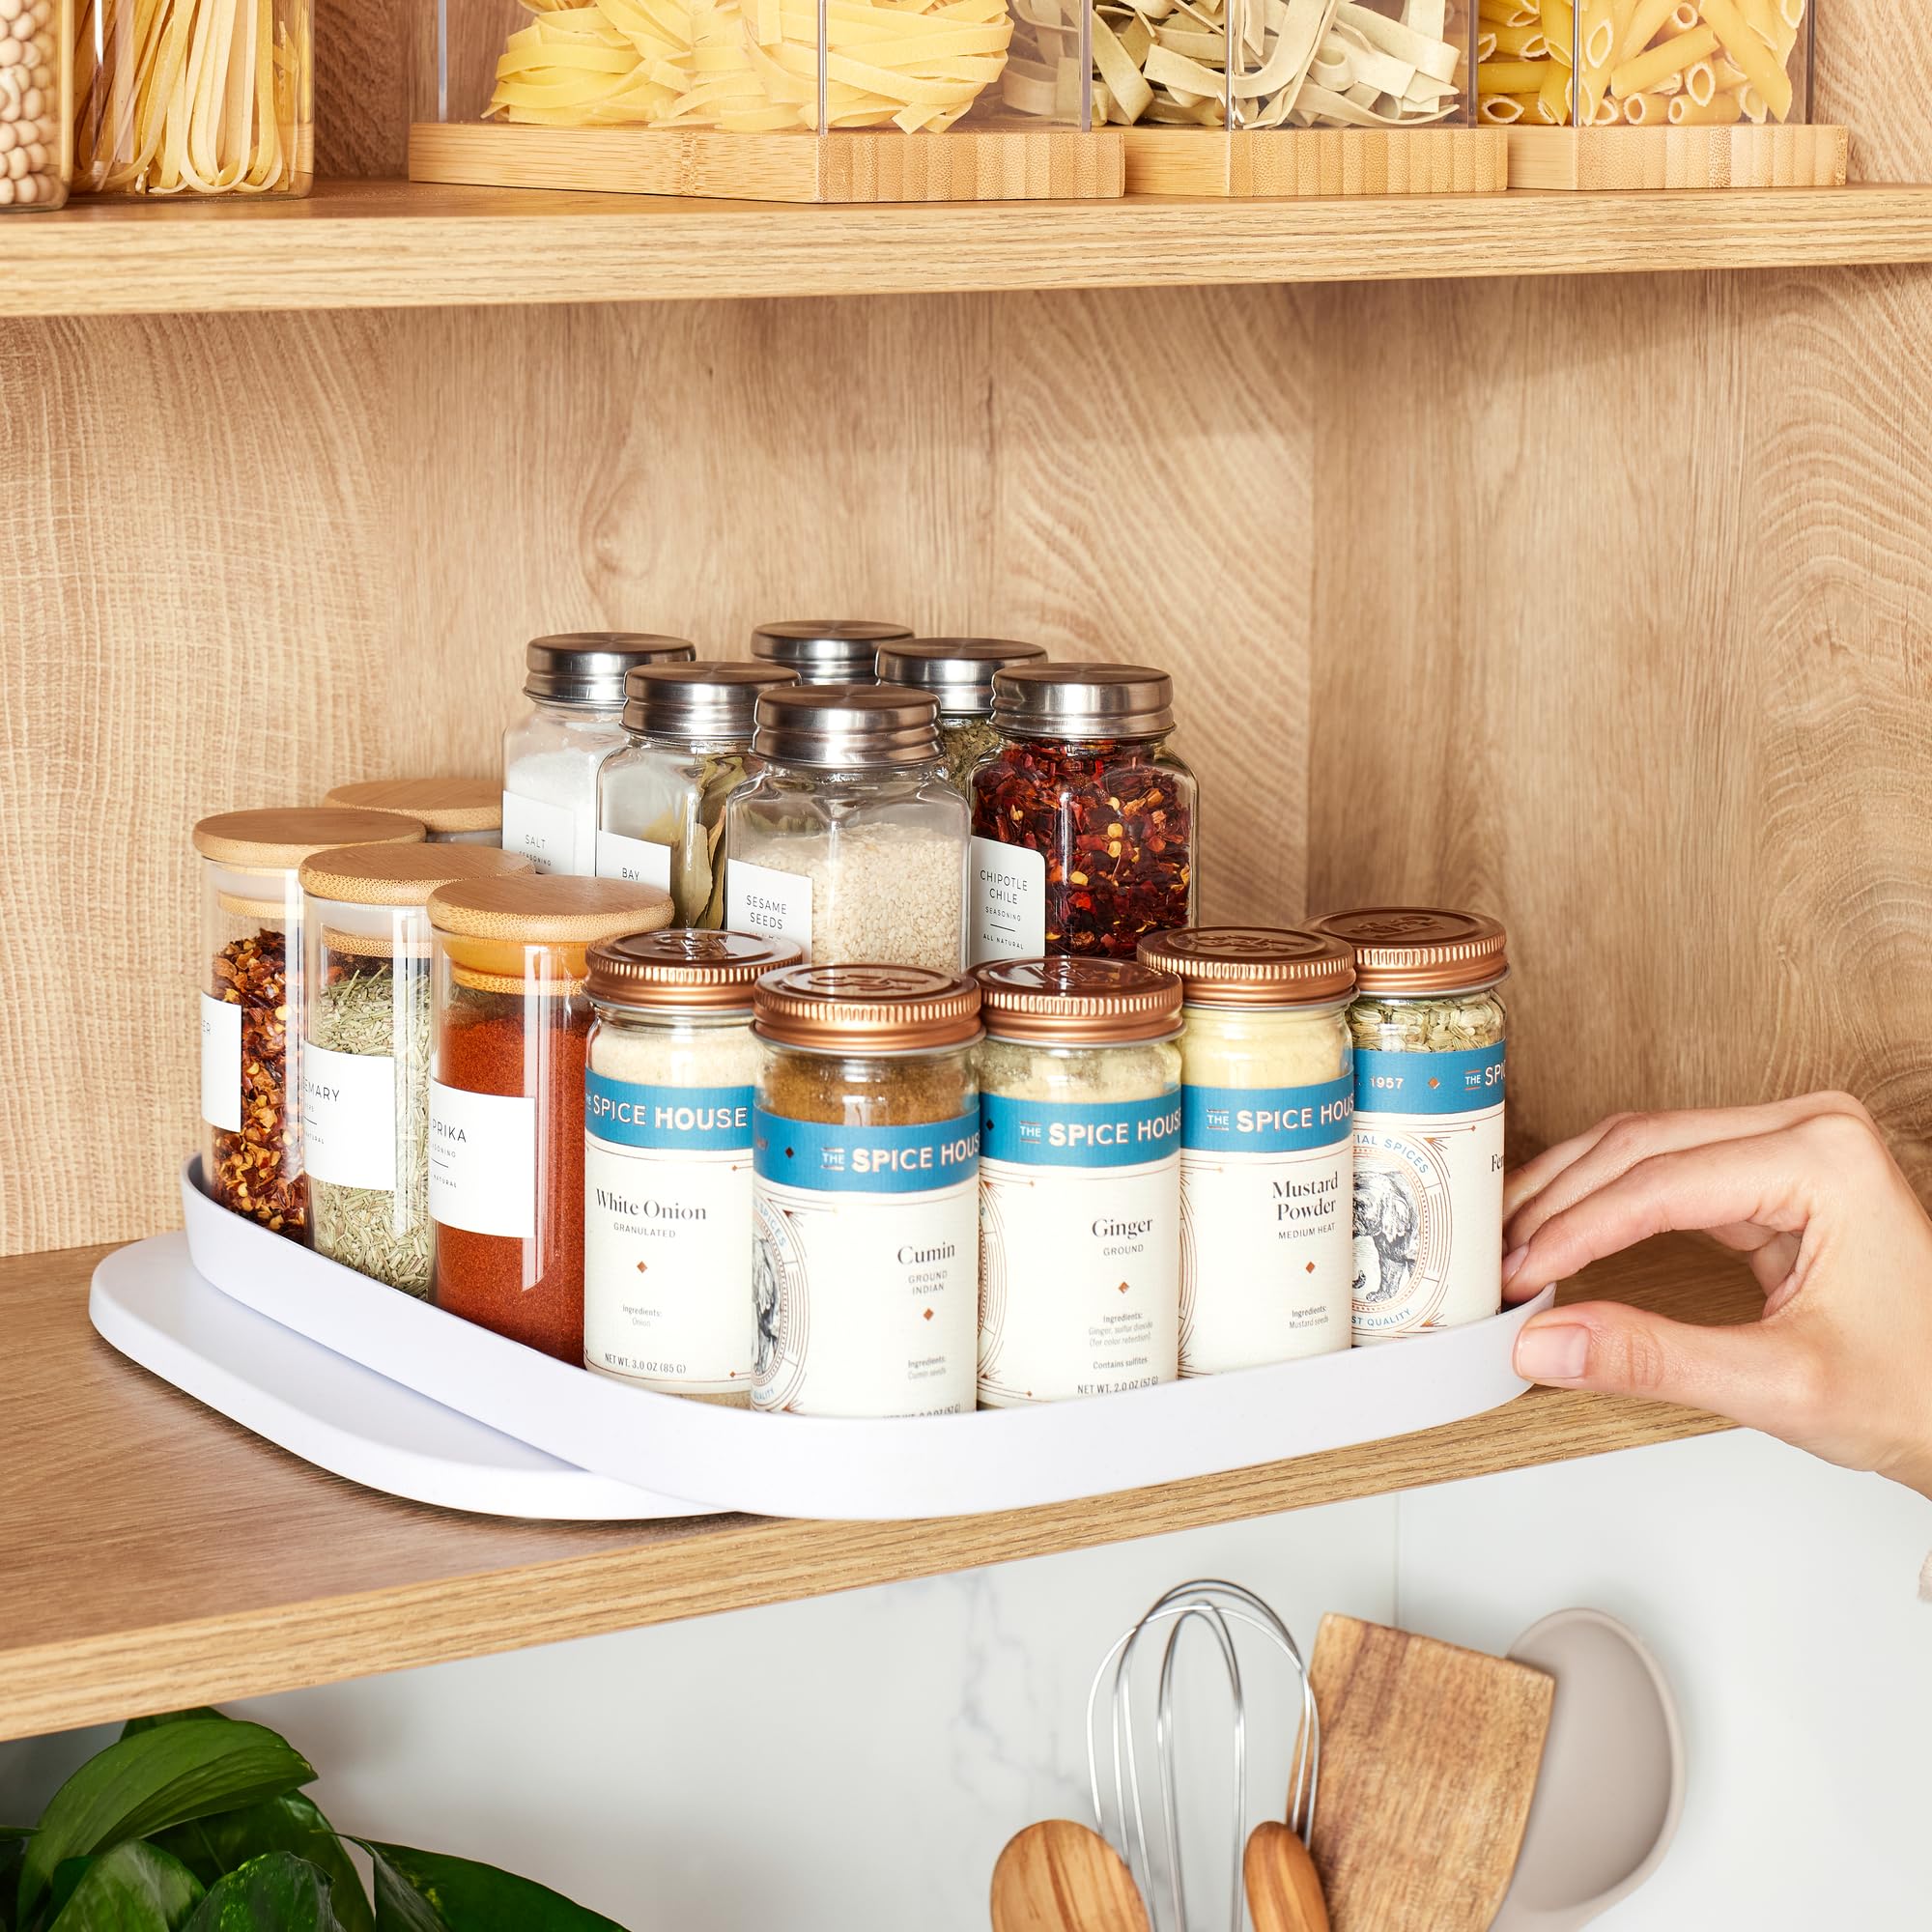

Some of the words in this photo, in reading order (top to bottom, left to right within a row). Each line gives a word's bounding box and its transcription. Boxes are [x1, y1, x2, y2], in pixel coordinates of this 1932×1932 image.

[525, 834, 546, 849] SALT
[622, 867, 640, 881] BAY
[980, 869, 1028, 892] CHIPOTLE
[746, 895, 787, 915] SESAME
[989, 888, 1018, 905] CHILE
[750, 912, 783, 930] SEEDS
[985, 906, 1021, 922] SEASONING
[982, 933, 994, 942] ALL
[996, 937, 1024, 951] NATURAL
[1370, 1075, 1405, 1090] 1957
[1464, 1074, 1481, 1085] THE
[593, 1094, 646, 1126] SPICE
[655, 1106, 748, 1131] HOUSE
[1208, 1114, 1230, 1126] THE
[1236, 1107, 1313, 1133] SPICE
[1020, 1125, 1041, 1138] THE
[1048, 1122, 1129, 1148] SPICE
[821, 1151, 845, 1165] THE
[852, 1147, 933, 1173] SPICE
[1352, 1133, 1378, 1146] IAL
[1383, 1138, 1429, 1175] SPICES
[1272, 1171, 1338, 1200] Mustard
[596, 1188, 639, 1215] White
[643, 1199, 707, 1220] Onion
[1277, 1197, 1337, 1221] Powder
[613, 1222, 676, 1238] GRANULATED
[1092, 1218, 1153, 1240] Ginger
[1278, 1228, 1316, 1240] MEDIUM
[1318, 1222, 1336, 1234] HEAT
[897, 1241, 956, 1265] Cumin
[1103, 1243, 1145, 1257] GROUND
[908, 1269, 949, 1284] GROUND
[912, 1283, 945, 1295] INDIAN
[622, 1303, 663, 1319] Ingredients:
[1367, 1307, 1412, 1327] QUALITY
[1289, 1319, 1314, 1329] Mustard
[605, 1352, 617, 1365] NET
[618, 1356, 630, 1368] WT.
[632, 1359, 644, 1371] 3.0
[646, 1360, 658, 1372] OZ
[660, 1362, 674, 1374] (85
[676, 1363, 687, 1375] G)
[1093, 1357, 1124, 1370] Contains
[1077, 1384, 1094, 1395] NET
[1097, 1383, 1112, 1395] WT.
[1114, 1381, 1127, 1393] 2.0
[1129, 1378, 1139, 1391] OZ
